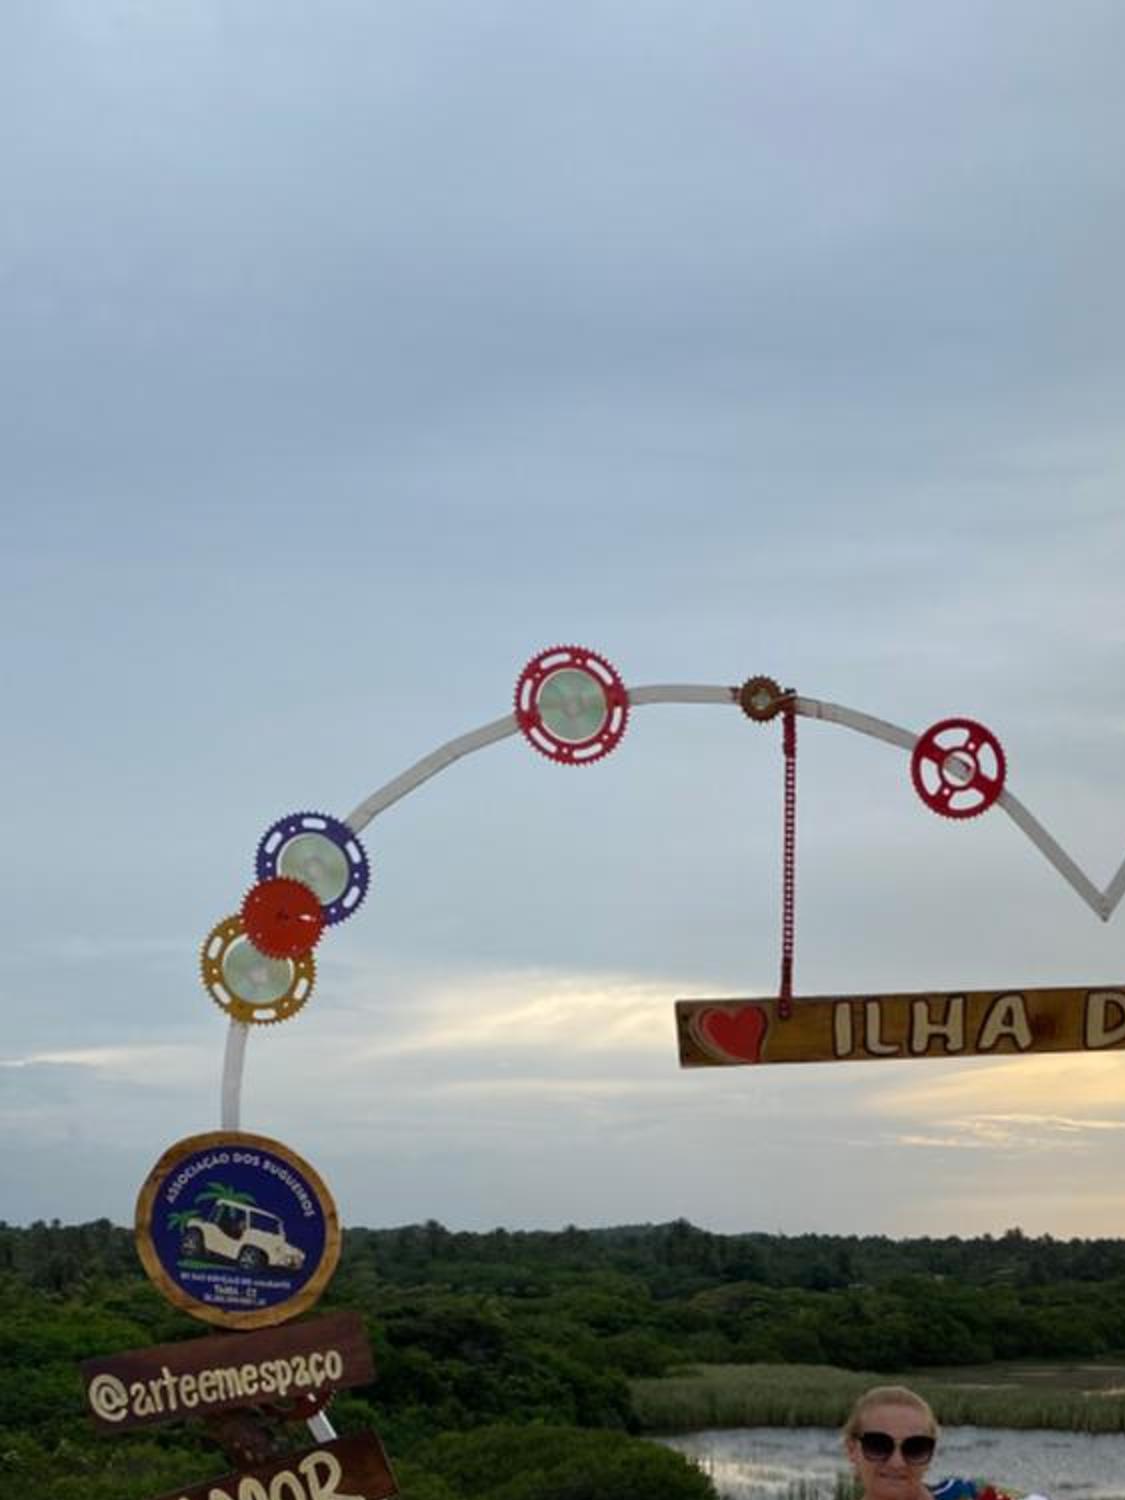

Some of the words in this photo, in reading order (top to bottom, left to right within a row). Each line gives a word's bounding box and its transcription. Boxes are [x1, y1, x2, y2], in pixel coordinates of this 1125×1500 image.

[833, 991, 1032, 1058] ILHA
[232, 1152, 261, 1167] DOS
[88, 1350, 343, 1421] @arteemespaço
